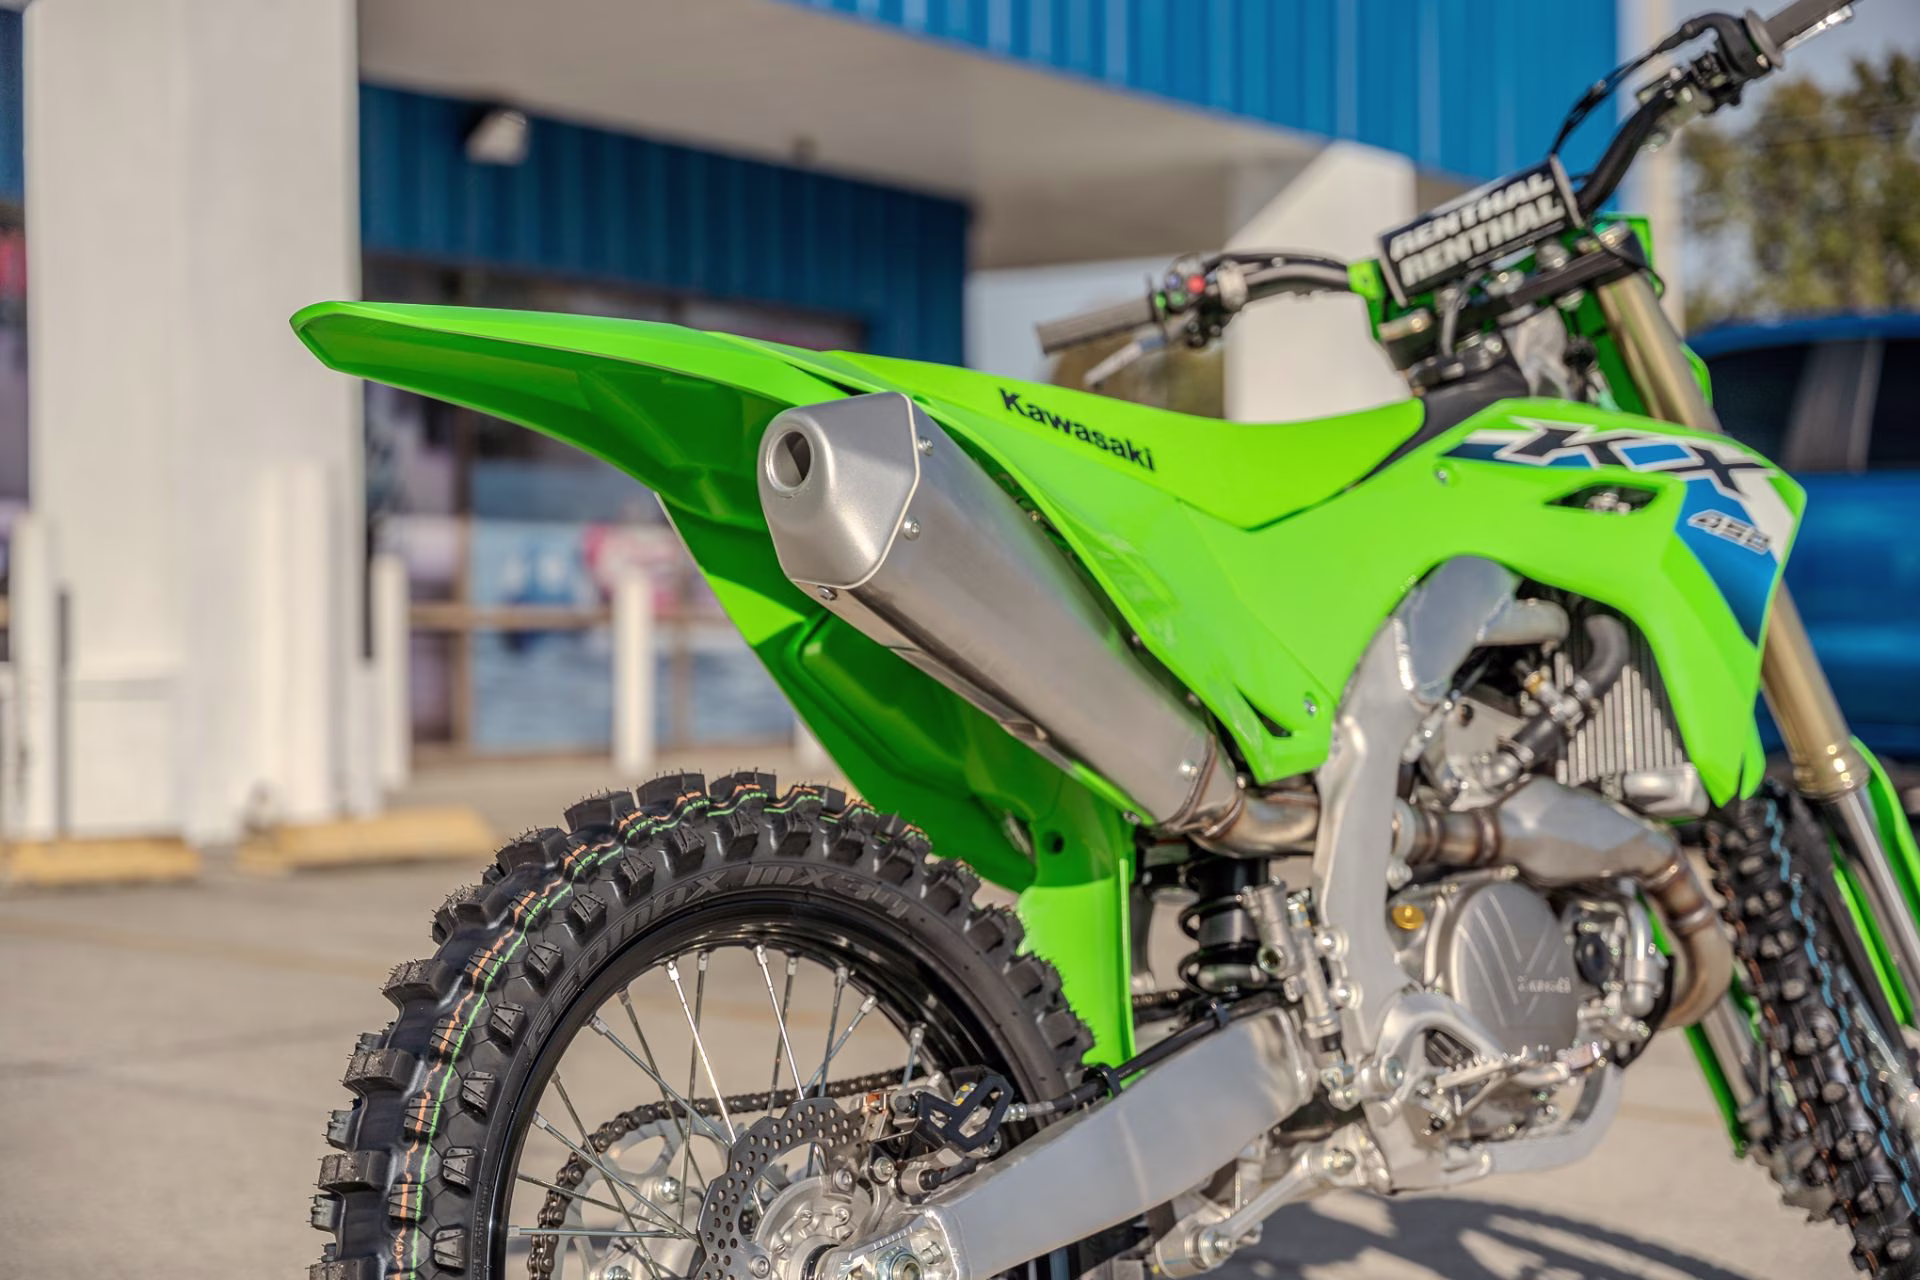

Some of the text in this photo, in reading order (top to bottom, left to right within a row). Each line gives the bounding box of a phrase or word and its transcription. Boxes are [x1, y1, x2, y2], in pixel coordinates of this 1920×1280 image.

[1389, 172, 1555, 262] RENTHAL
[1399, 194, 1566, 288] RENTHAL
[998, 386, 1156, 472] Kawasaki
